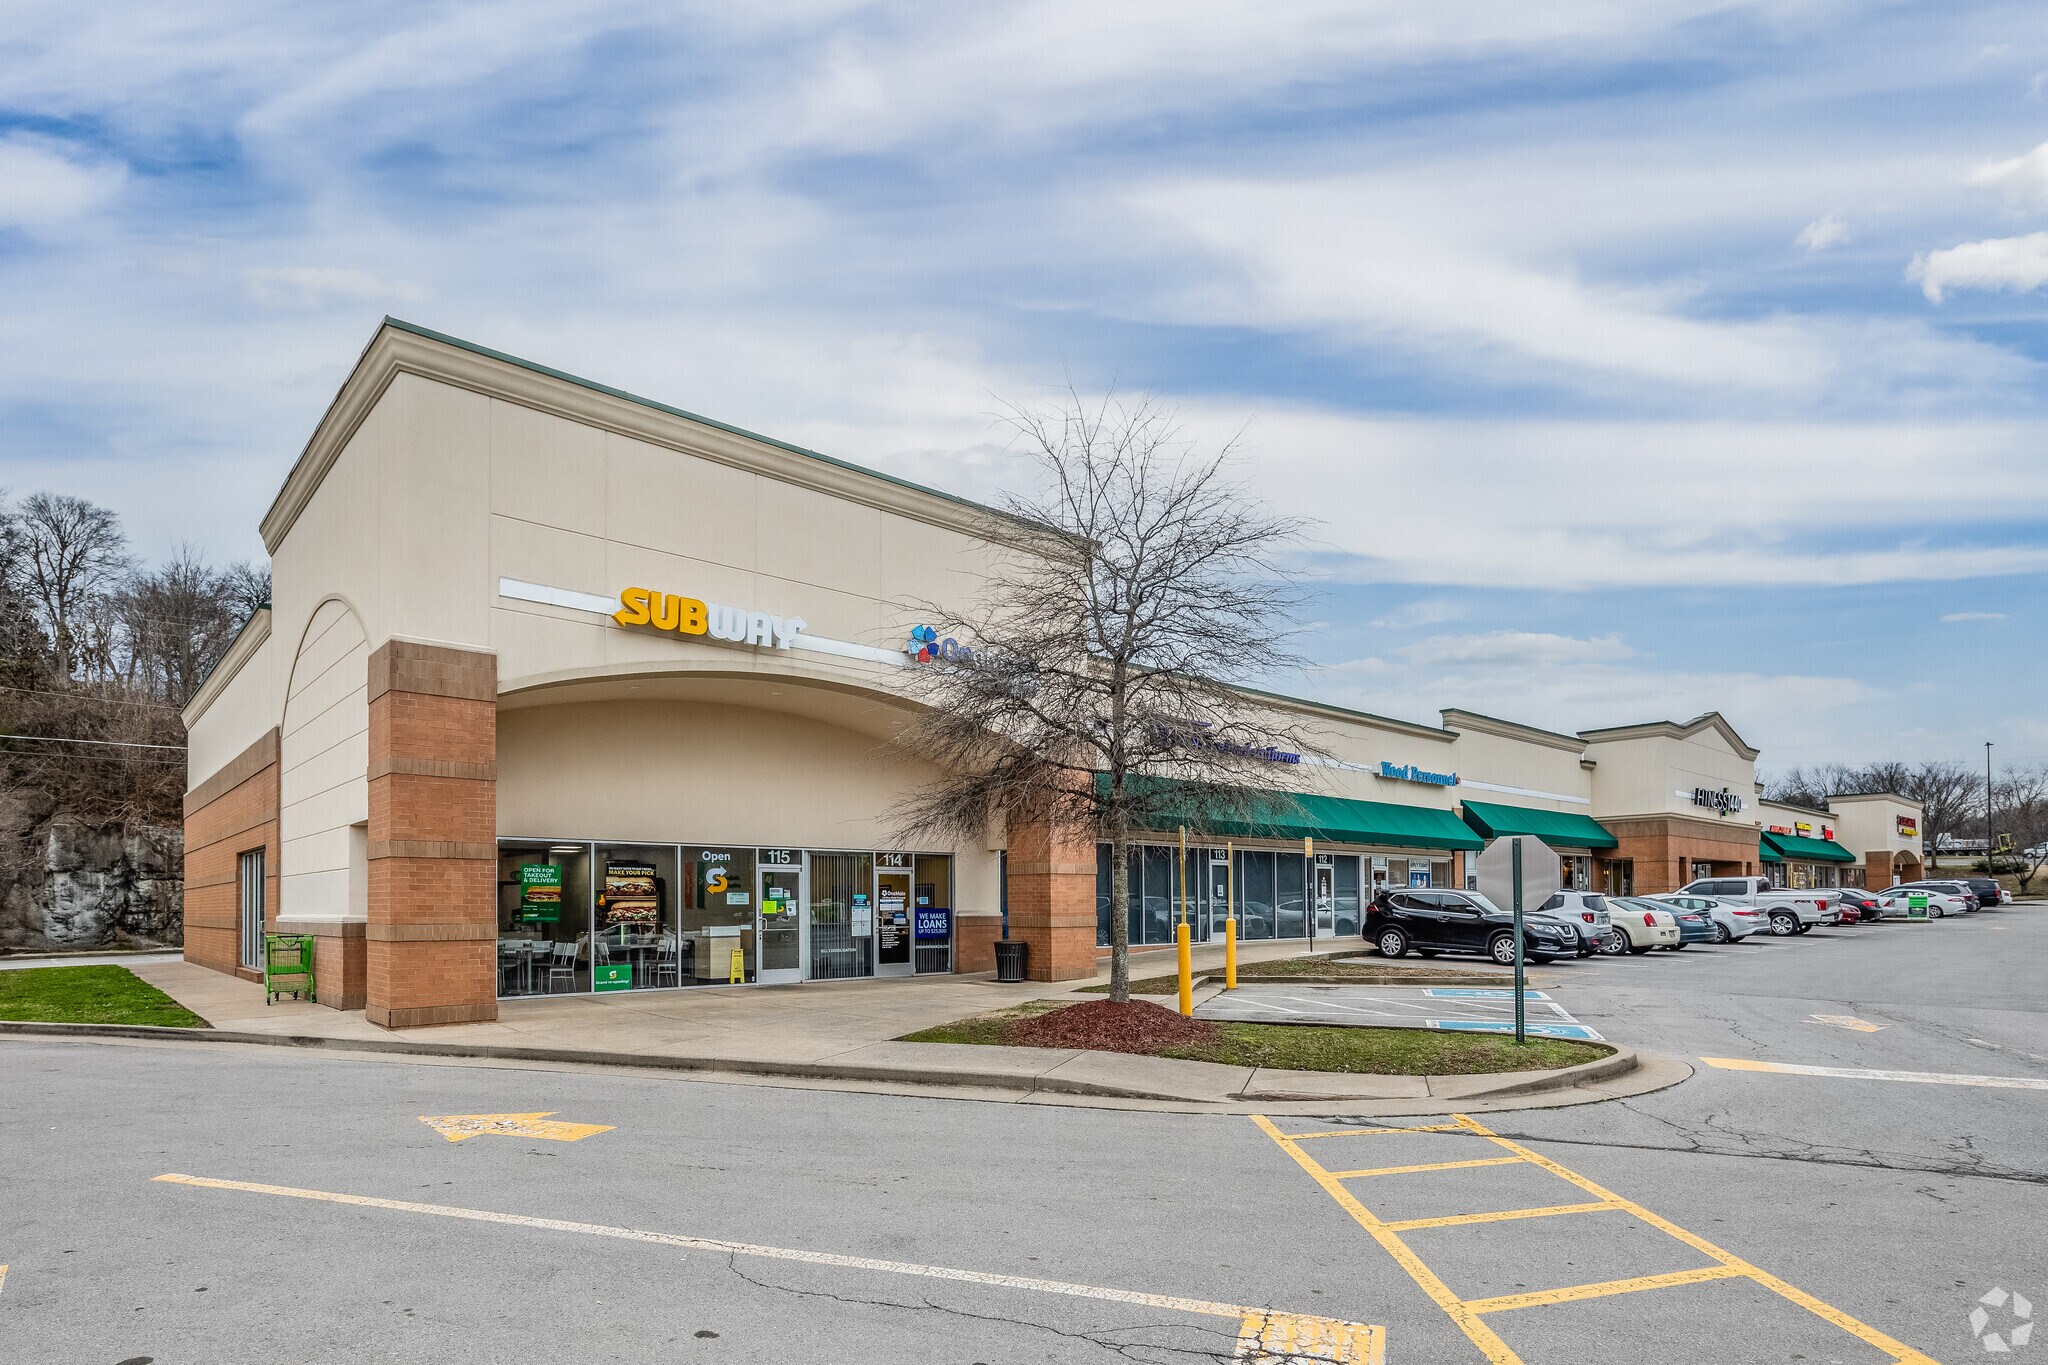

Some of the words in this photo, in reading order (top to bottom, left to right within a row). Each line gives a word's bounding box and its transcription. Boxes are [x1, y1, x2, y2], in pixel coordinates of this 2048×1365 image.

[611, 586, 808, 650] SUBWAY
[1380, 760, 1409, 780] Wood
[1411, 766, 1457, 787] Personnel
[702, 851, 731, 863] Open
[768, 849, 790, 864] 115
[884, 853, 902, 866] 114
[1214, 849, 1226, 860] 113
[1318, 854, 1328, 864] 112
[918, 912, 929, 920] WE
[929, 912, 946, 920] MAKE
[918, 919, 947, 929] LOANS
